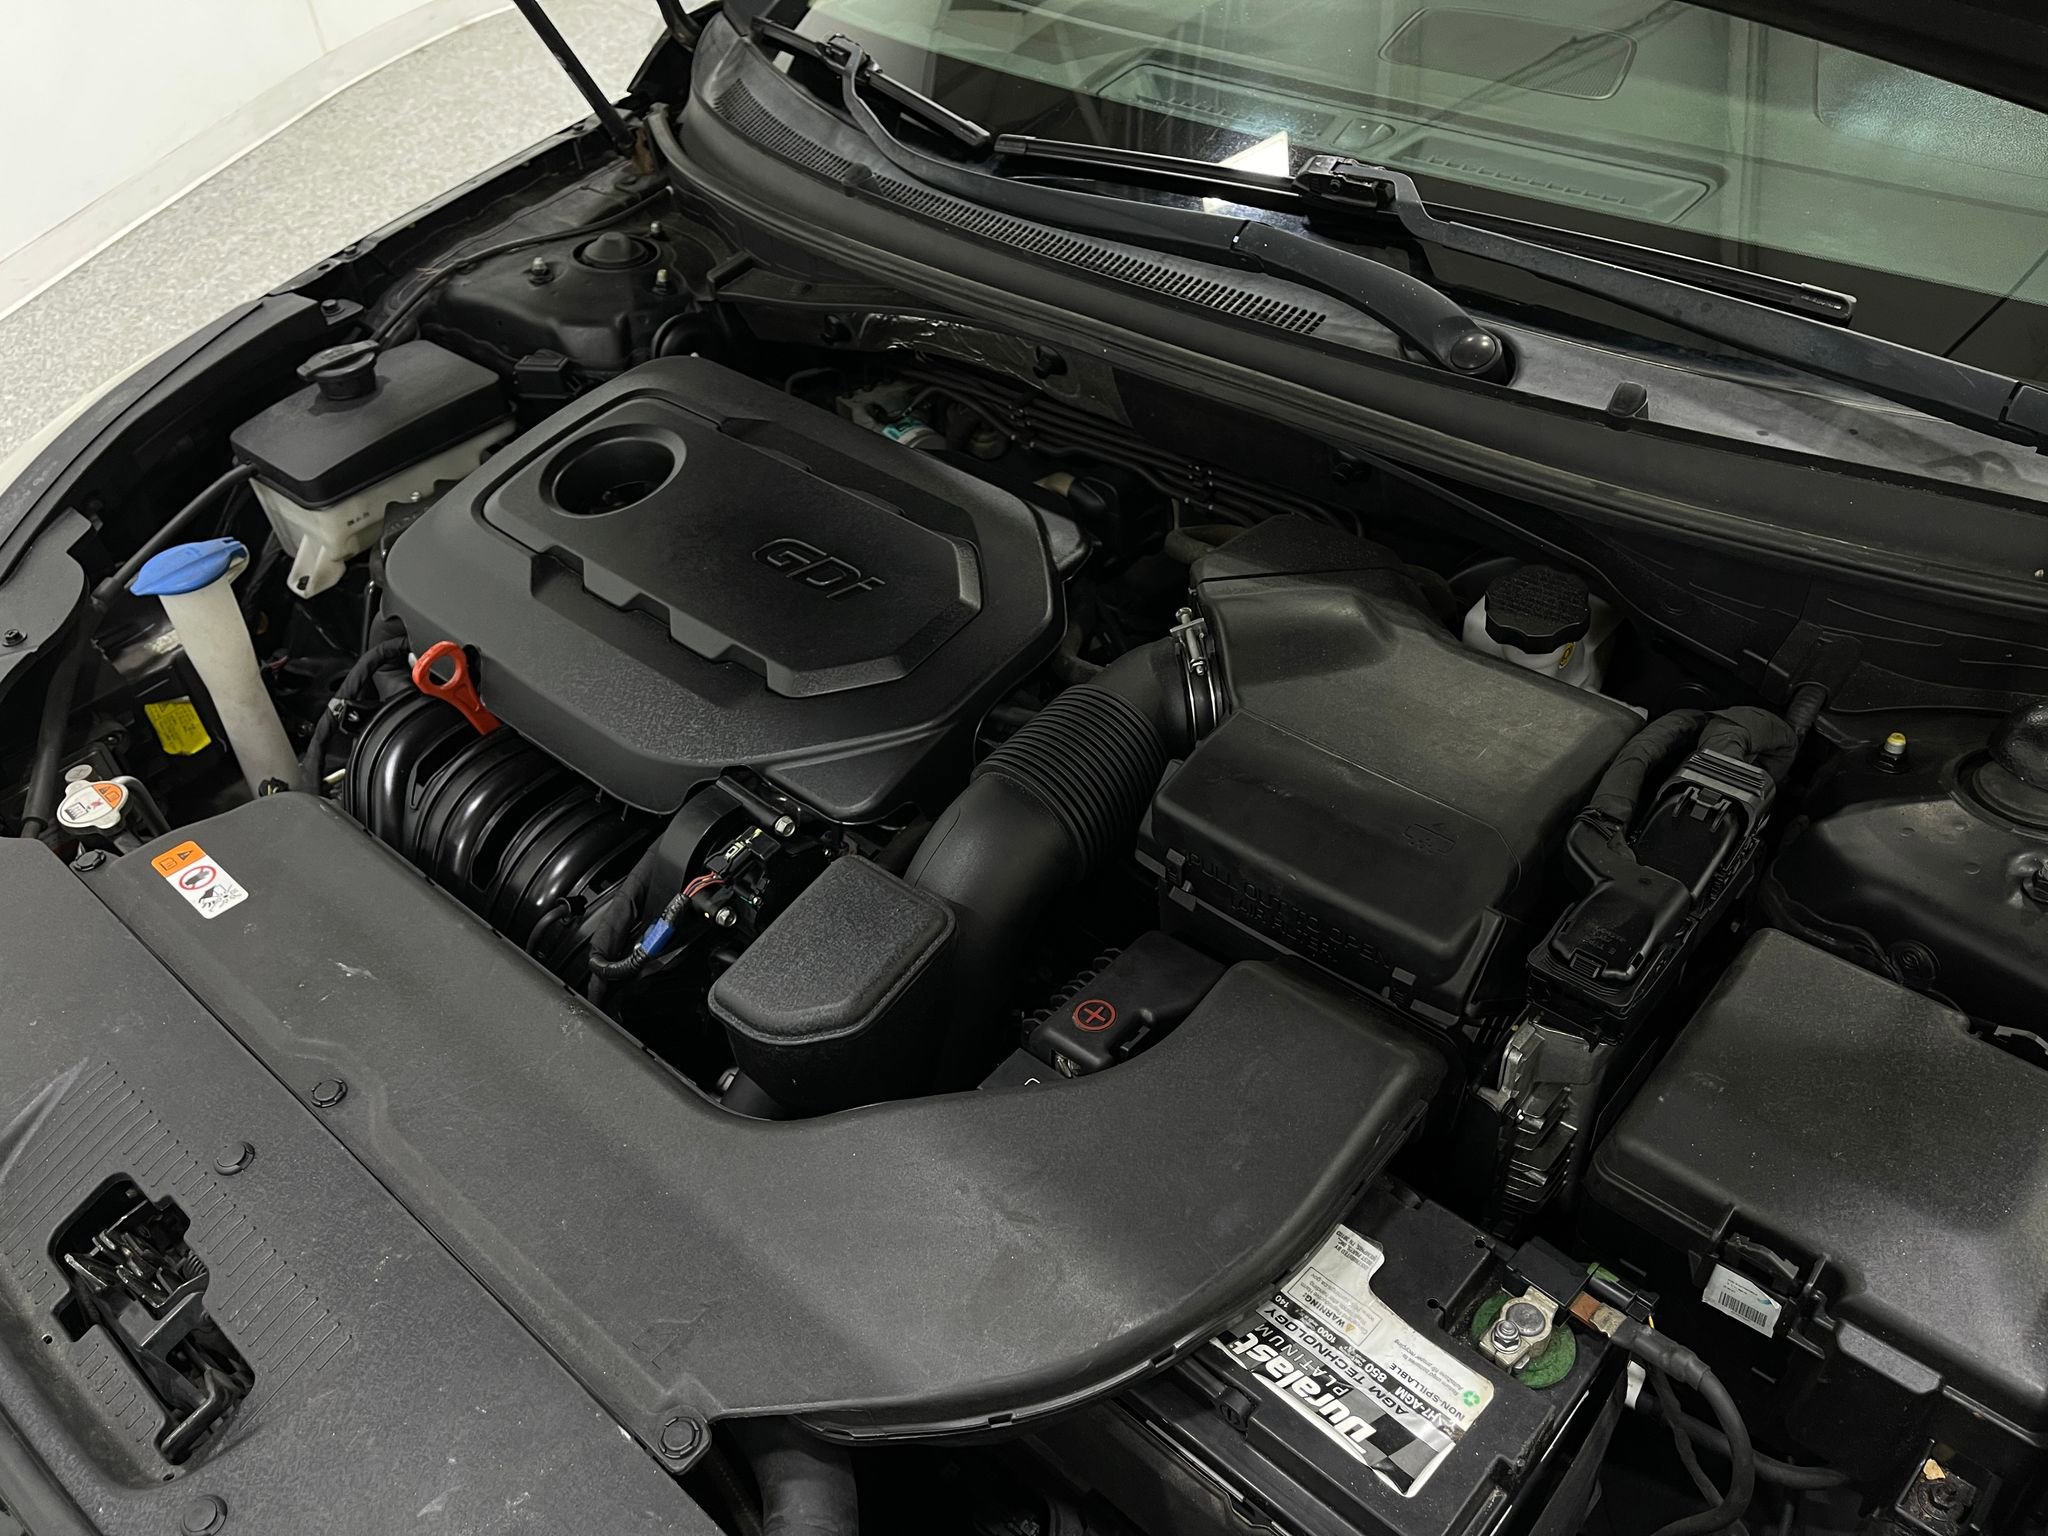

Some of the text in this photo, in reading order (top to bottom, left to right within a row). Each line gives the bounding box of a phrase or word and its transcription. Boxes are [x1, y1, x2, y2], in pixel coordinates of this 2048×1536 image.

[1185, 850, 1237, 891] PULL
[1244, 883, 1286, 914] OUT
[1328, 926, 1390, 969] OPEN
[1333, 1243, 1341, 1251] BY
[1274, 1294, 1290, 1308] 140
[1301, 1291, 1345, 1327] WARNING:
[1264, 1308, 1366, 1384] TECHNOLOGY
[1316, 1325, 1337, 1344] 1000
[1252, 1322, 1349, 1396] PLATINUM
[1363, 1361, 1388, 1383] 850
[1229, 1331, 1376, 1455] Duralast
[1367, 1384, 1408, 1413] AGM
[1389, 1362, 1465, 1421] NON-SPILLABLE
[1393, 1385, 1439, 1423] H7-AGM
